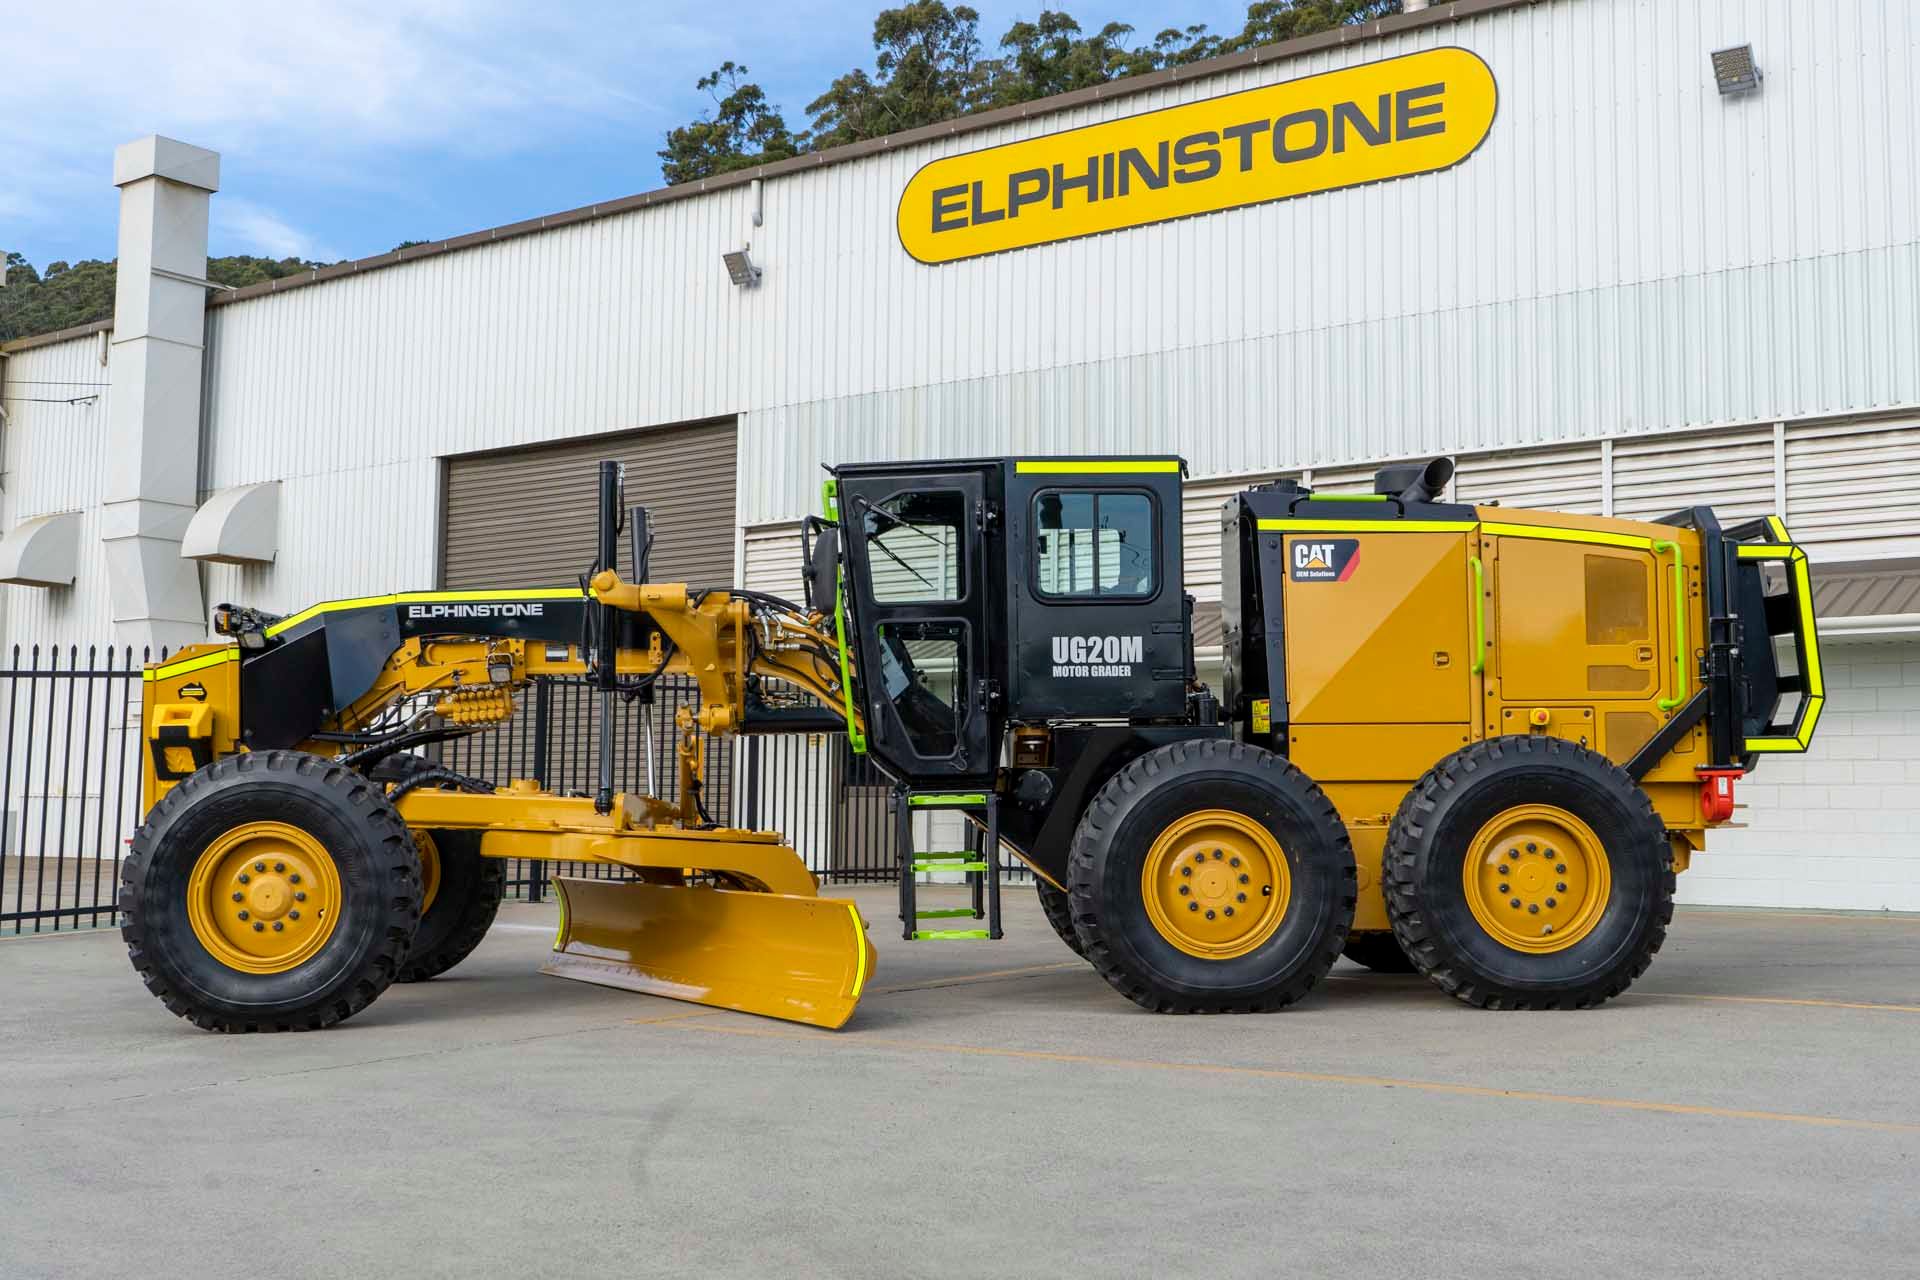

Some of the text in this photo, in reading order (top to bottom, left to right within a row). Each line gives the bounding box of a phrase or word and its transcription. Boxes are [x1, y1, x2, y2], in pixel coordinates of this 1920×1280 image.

[932, 82, 1445, 233] ELPHINSTONE
[1295, 544, 1335, 568] CAT
[409, 604, 543, 618] ELPHINSTONE
[1052, 636, 1143, 664] UG20M
[1052, 665, 1131, 677] MOTOR GRADER
